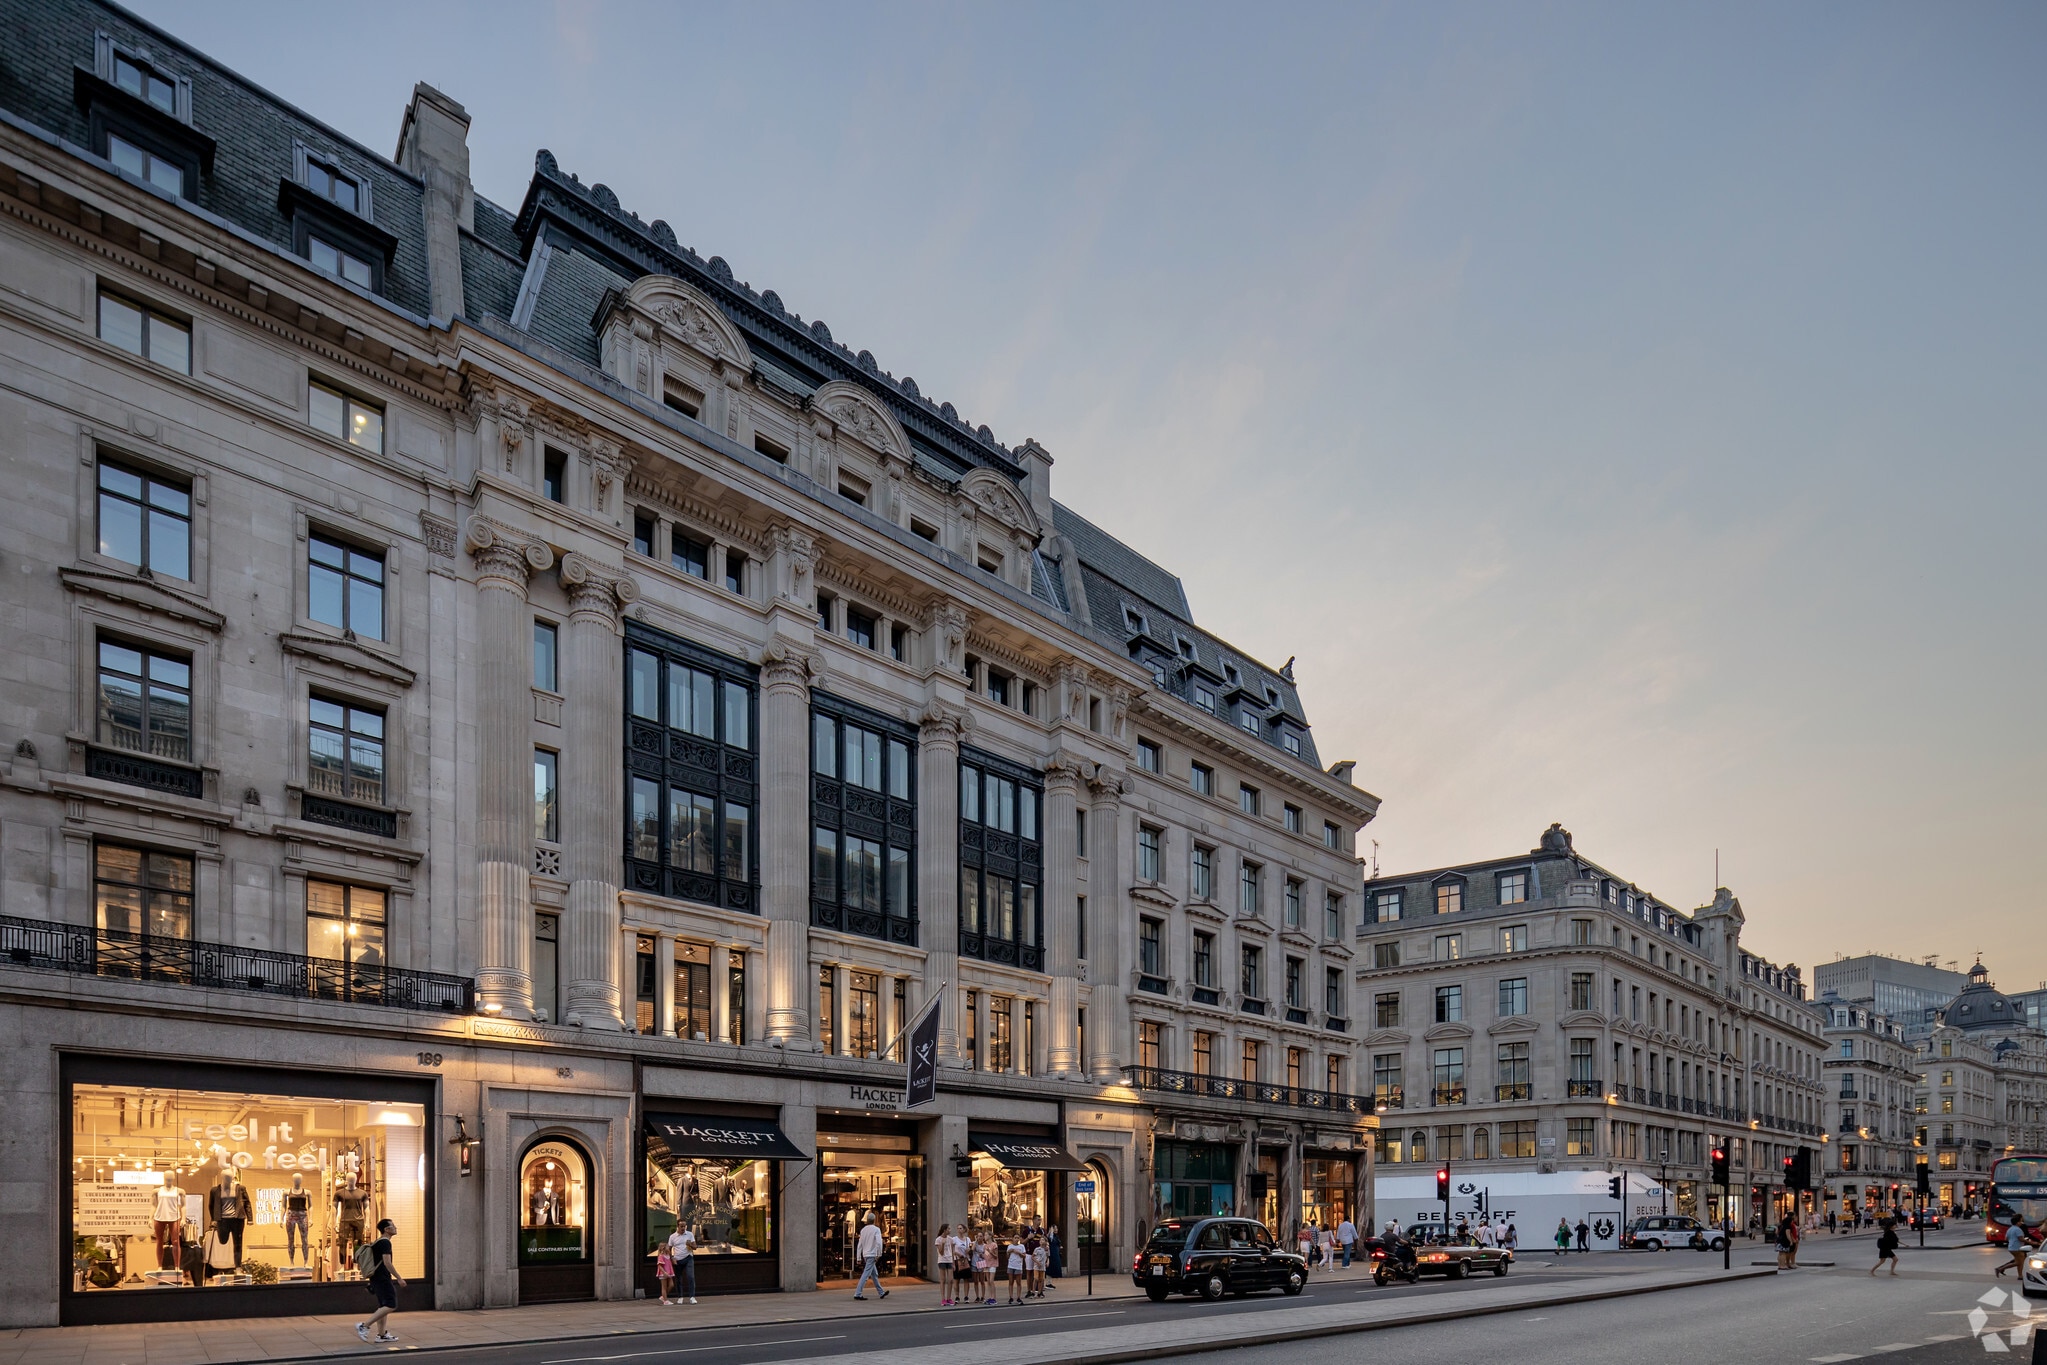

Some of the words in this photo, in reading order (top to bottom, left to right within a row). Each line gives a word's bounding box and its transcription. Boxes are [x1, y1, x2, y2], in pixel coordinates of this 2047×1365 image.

[417, 1052, 443, 1067] 189
[183, 1118, 259, 1143] Feel
[268, 1122, 294, 1144] it
[664, 1125, 776, 1142] HACKETT
[700, 1137, 758, 1145] LONDON
[532, 1148, 563, 1157] TICKETS
[984, 1144, 1060, 1155] HACKETT
[217, 1147, 254, 1169] to
[262, 1146, 326, 1172] feel
[336, 1152, 360, 1172] it
[1418, 1211, 1516, 1220] BELSTAFF
